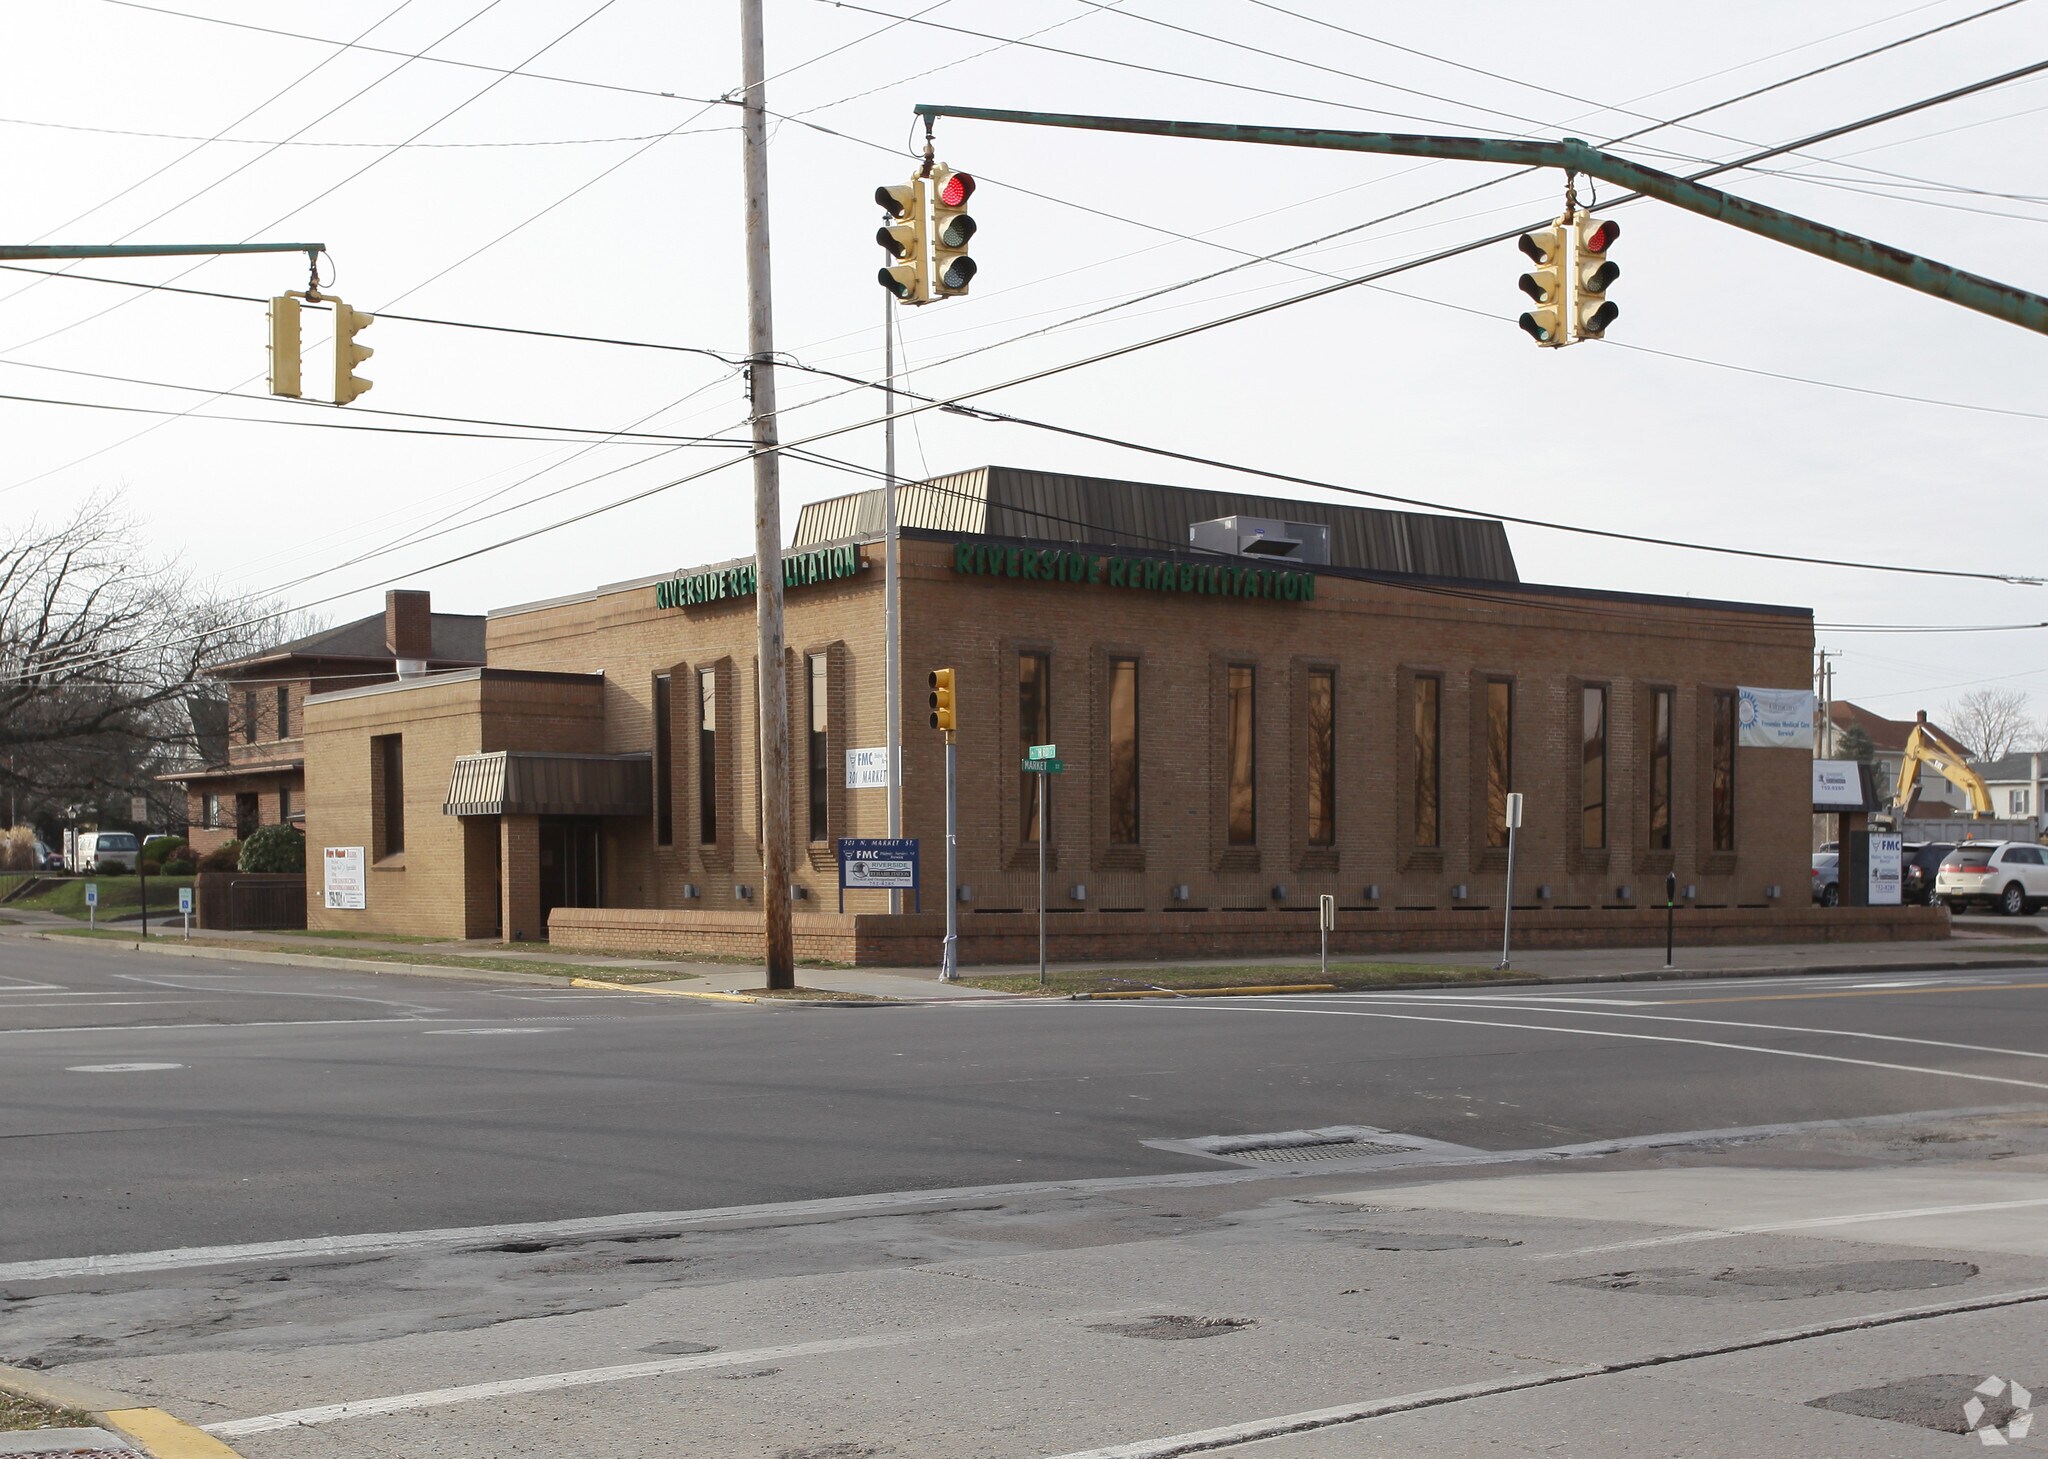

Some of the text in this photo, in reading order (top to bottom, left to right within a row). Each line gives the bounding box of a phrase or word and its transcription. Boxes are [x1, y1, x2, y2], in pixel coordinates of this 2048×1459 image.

[656, 543, 856, 609] RIVERSIDE REHLITATION
[956, 543, 1315, 601] RIVERSIDE REHABILITATION
[857, 752, 873, 766] FMC
[1024, 760, 1047, 770] MARKET
[862, 769, 887, 783] MARKET
[1882, 839, 1901, 851] FMC
[856, 850, 879, 859] FMC
